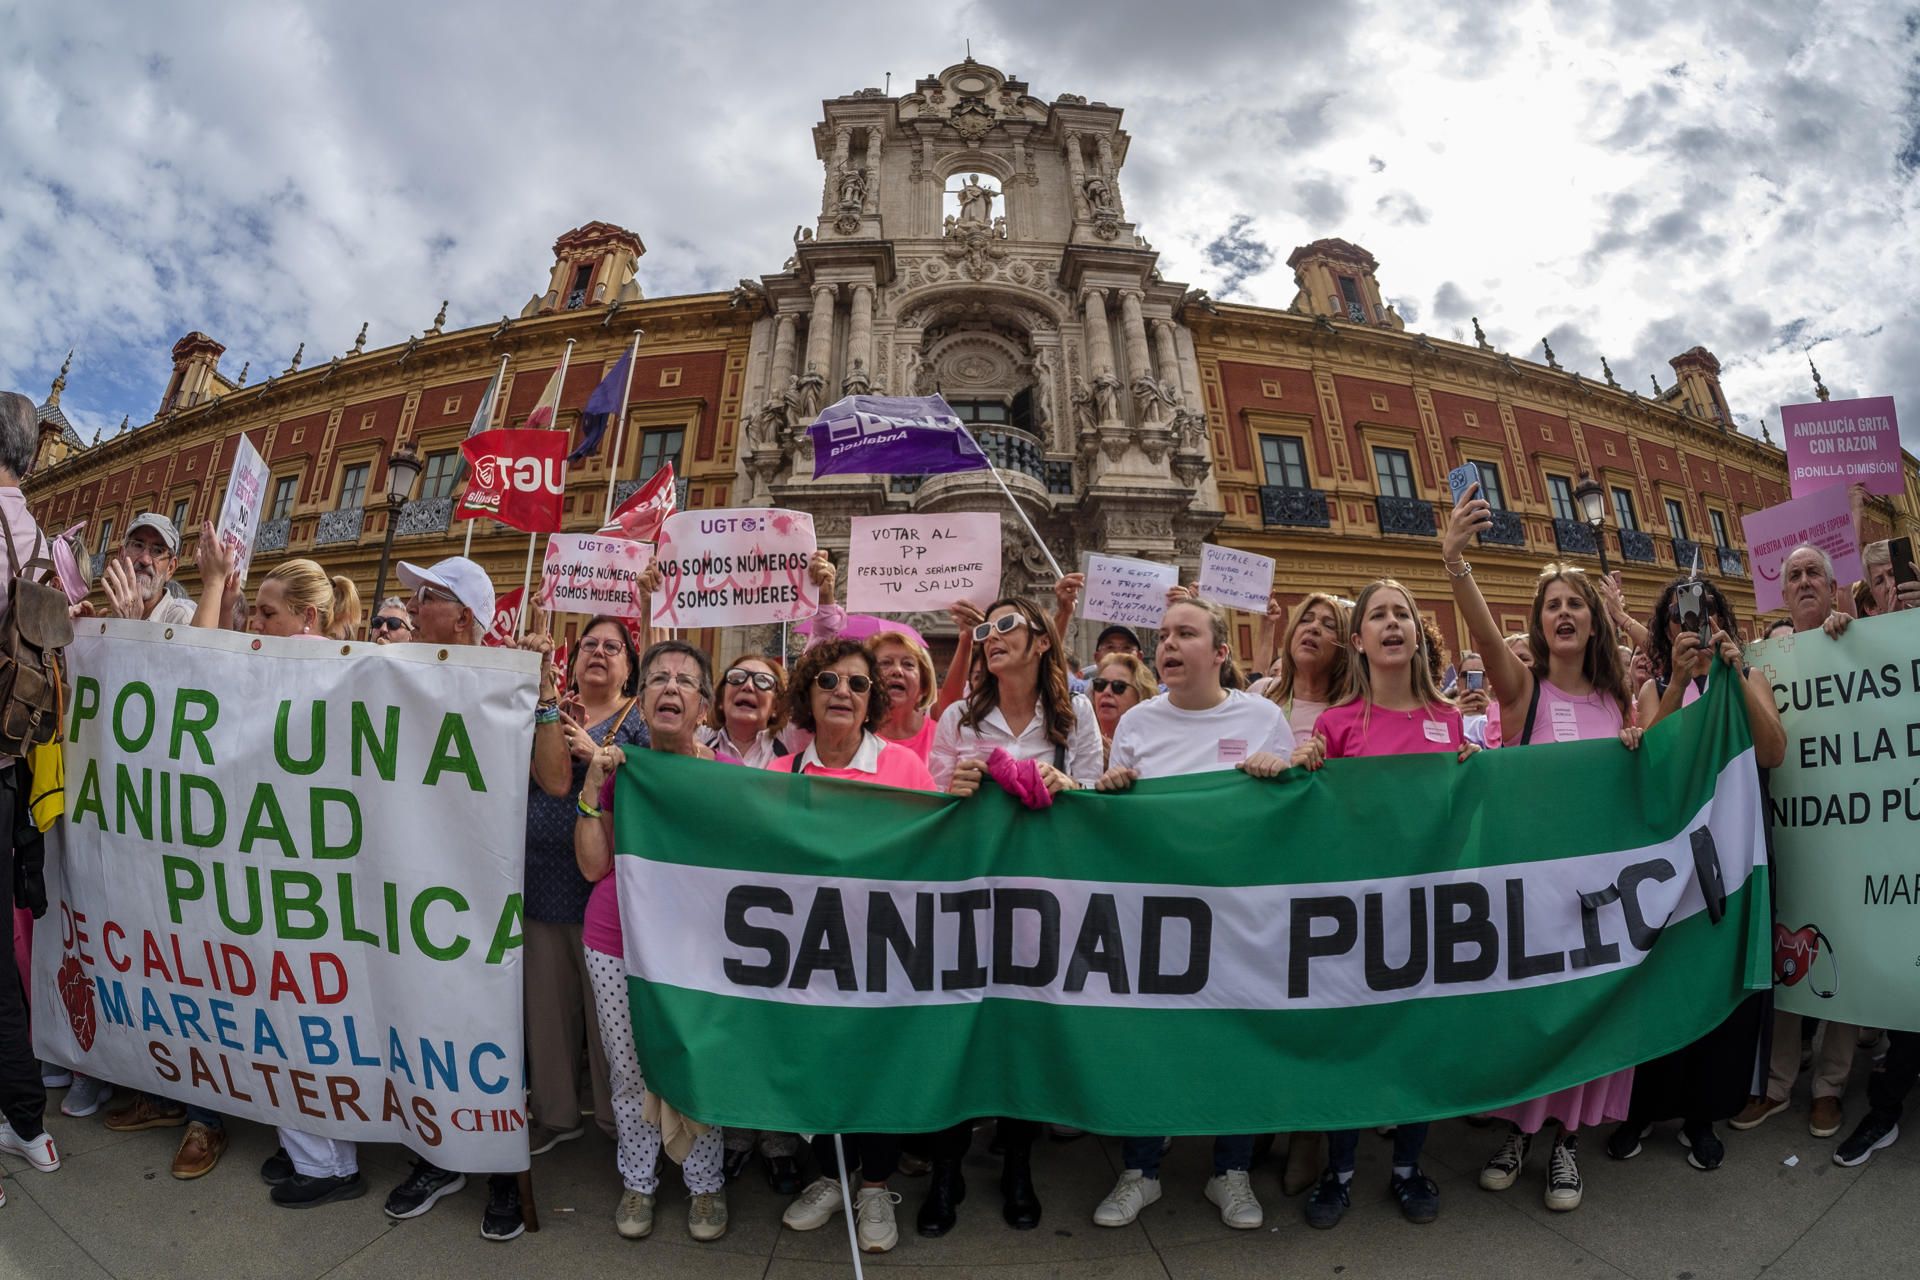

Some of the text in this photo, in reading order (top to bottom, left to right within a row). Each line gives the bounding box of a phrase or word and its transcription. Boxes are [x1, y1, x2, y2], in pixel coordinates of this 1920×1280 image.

[1794, 416, 1890, 437] ANDALUCÍA GRITA
[1810, 436, 1878, 454] CON RAZON
[1794, 460, 1898, 480] ¡BONILLA DIMISIÓN!
[701, 518, 738, 534] UGT
[872, 527, 957, 541] VOTAR AL
[1754, 514, 1851, 557] NUESTRA VIDA NO PUEDE ESPERAR
[578, 540, 603, 552] UGT
[900, 545, 927, 559] PP
[546, 564, 637, 582] NO SOMOS NÚMERO
[658, 550, 808, 577] NO SOMOS NÚMEROS
[857, 562, 983, 577] PERJUDICA SERIAMENTE
[555, 586, 633, 604] SOMOS MUJERES
[880, 577, 974, 594] TU SALUD
[1118, 580, 1152, 589] FRUTA
[677, 585, 799, 609] SOMOS MUJERES
[1772, 664, 1901, 714] CUEVAS
[69, 676, 487, 793] POR UNA
[1800, 734, 1841, 769] EN
[1853, 728, 1896, 763] LA
[72, 759, 362, 860] ANIDAD
[1771, 791, 1870, 828] NIDAD
[162, 855, 523, 965] PUBLICA
[722, 824, 1727, 999] SANIDAD PUBLICA
[59, 900, 349, 1005] DE CALIDAD
[301, 1014, 526, 1095] BLANC
[149, 1040, 443, 1147] SALTERAS
